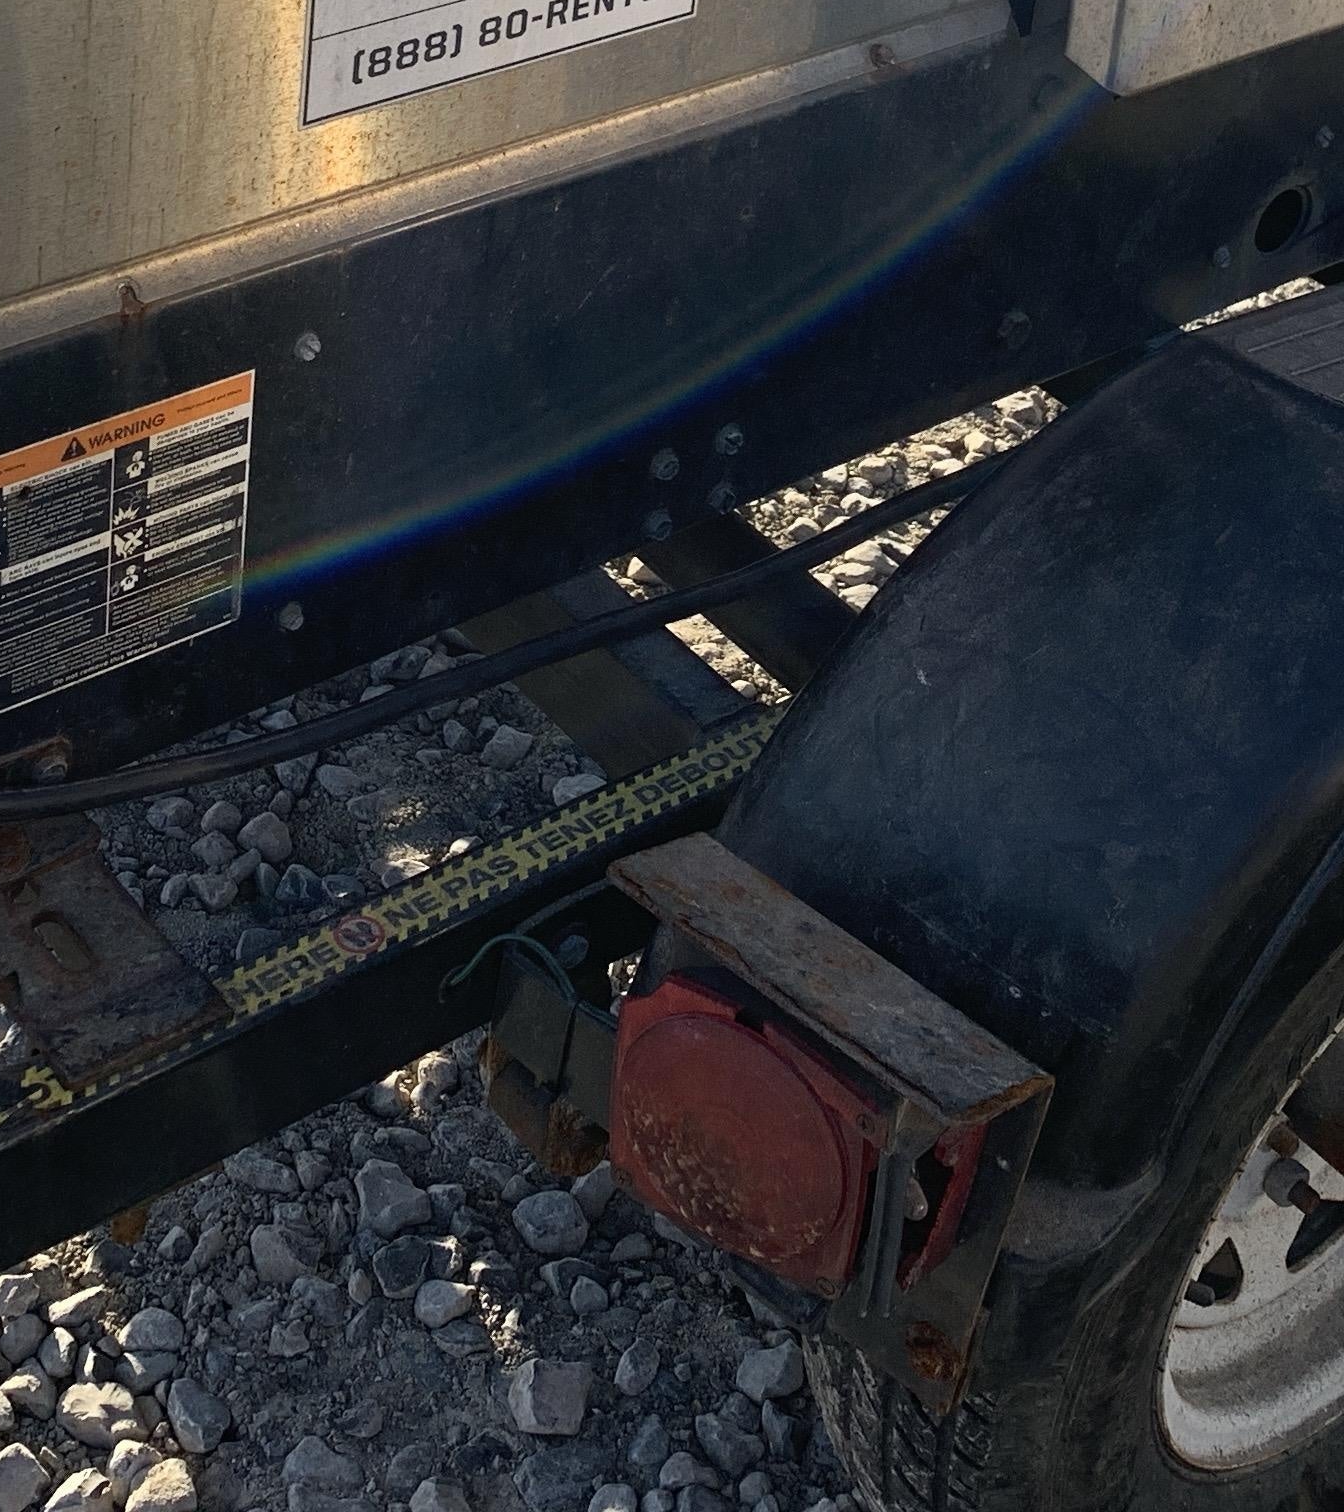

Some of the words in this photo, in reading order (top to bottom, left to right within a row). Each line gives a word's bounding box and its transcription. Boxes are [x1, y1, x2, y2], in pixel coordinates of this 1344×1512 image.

[351, 23, 463, 86] (888)
[88, 413, 166, 449] WARNING
[382, 891, 444, 928] NE
[441, 855, 518, 899] PAS
[516, 797, 636, 859] TENEZ
